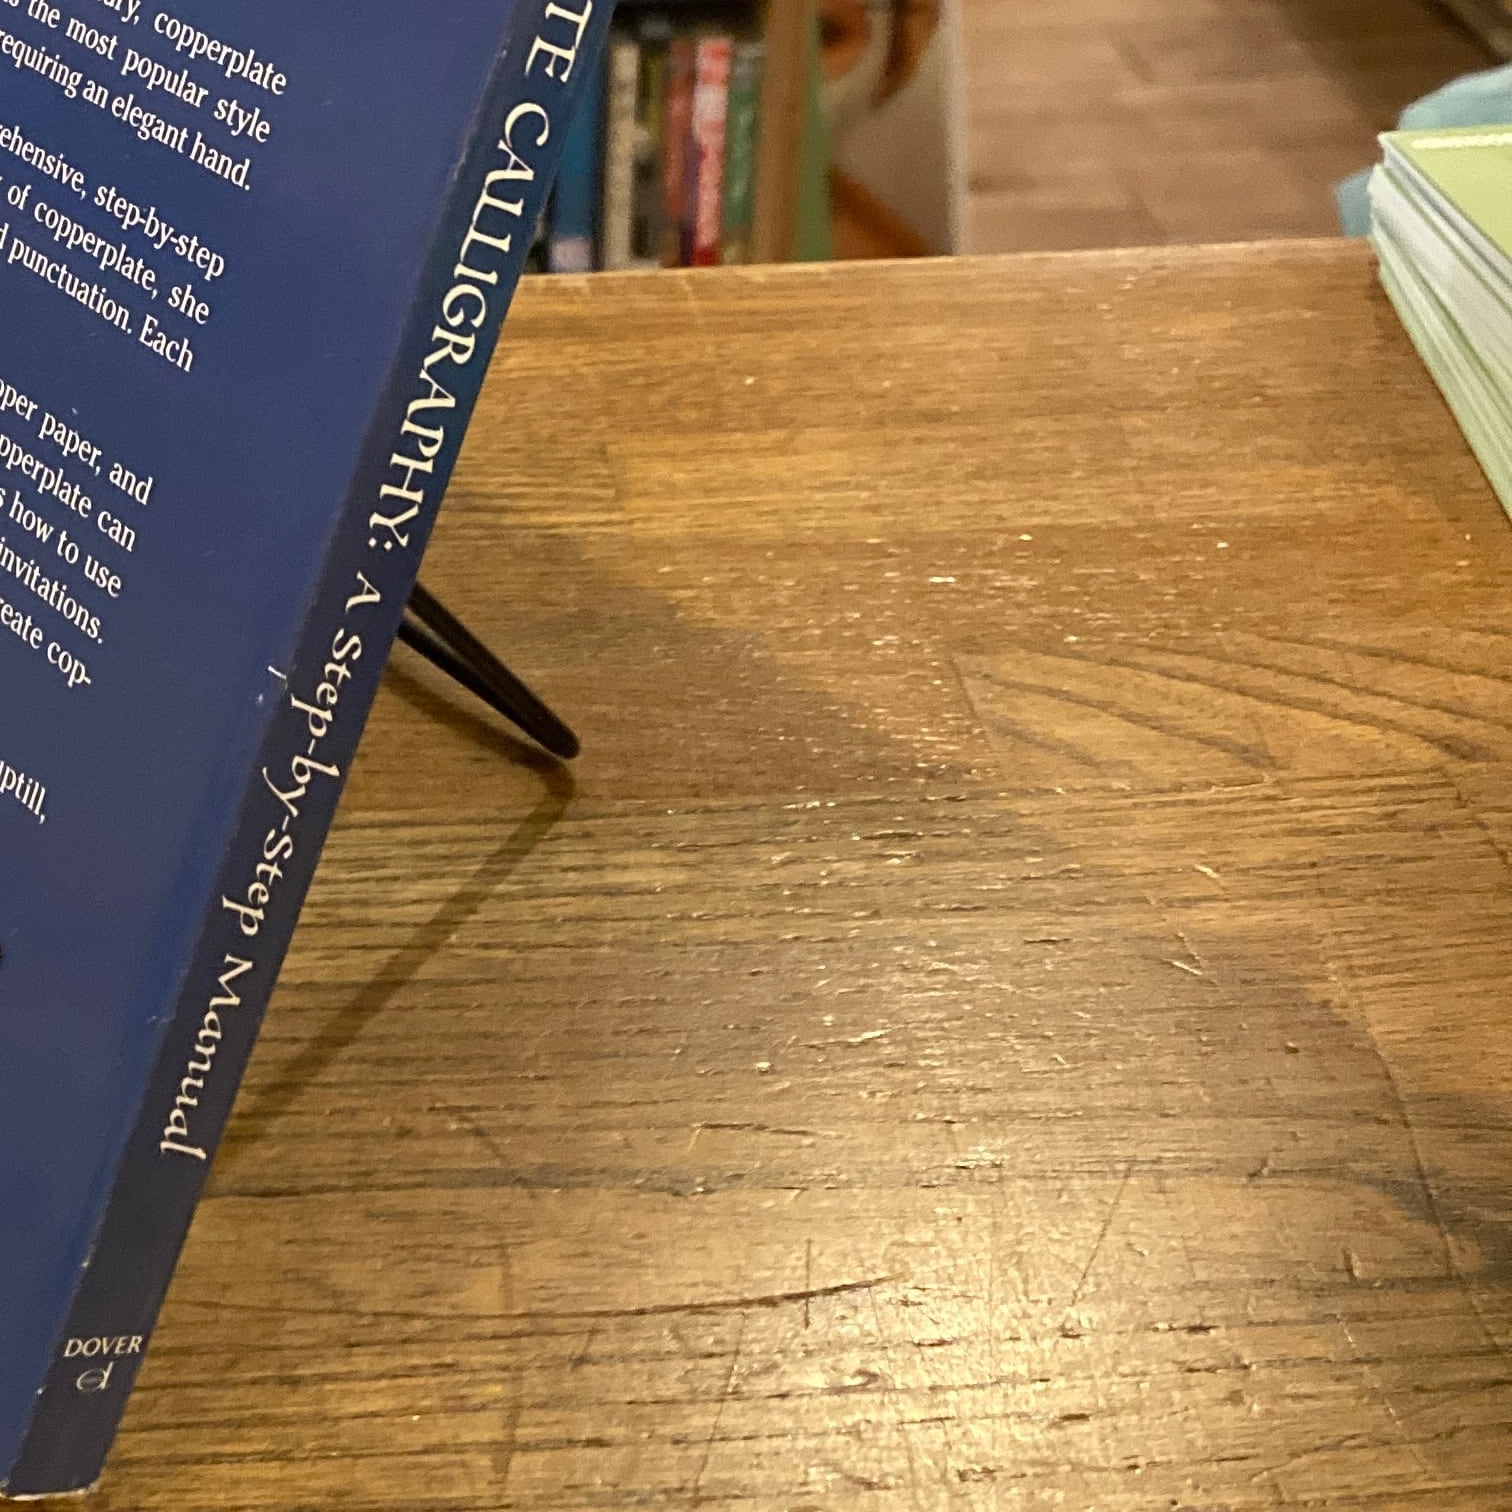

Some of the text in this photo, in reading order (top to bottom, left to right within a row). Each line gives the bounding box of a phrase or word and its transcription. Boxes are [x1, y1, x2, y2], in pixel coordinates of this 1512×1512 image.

[64, 18, 119, 63] most
[119, 48, 211, 110] popular
[212, 99, 272, 145] style
[152, 12, 288, 98] copperplate
[81, 80, 110, 111] an
[110, 93, 190, 156] elegant
[188, 131, 252, 193] hand.
[6, 184, 33, 213] of
[33, 201, 159, 302] copperplate,
[166, 284, 211, 327] she
[92, 185, 226, 284] step-by-step
[368, 101, 551, 551] CALLIGRAPHY:
[344, 571, 382, 615] A
[221, 627, 363, 938] Step-by-Step
[159, 953, 257, 1163] Manual
[63, 1334, 144, 1358] DOVER
